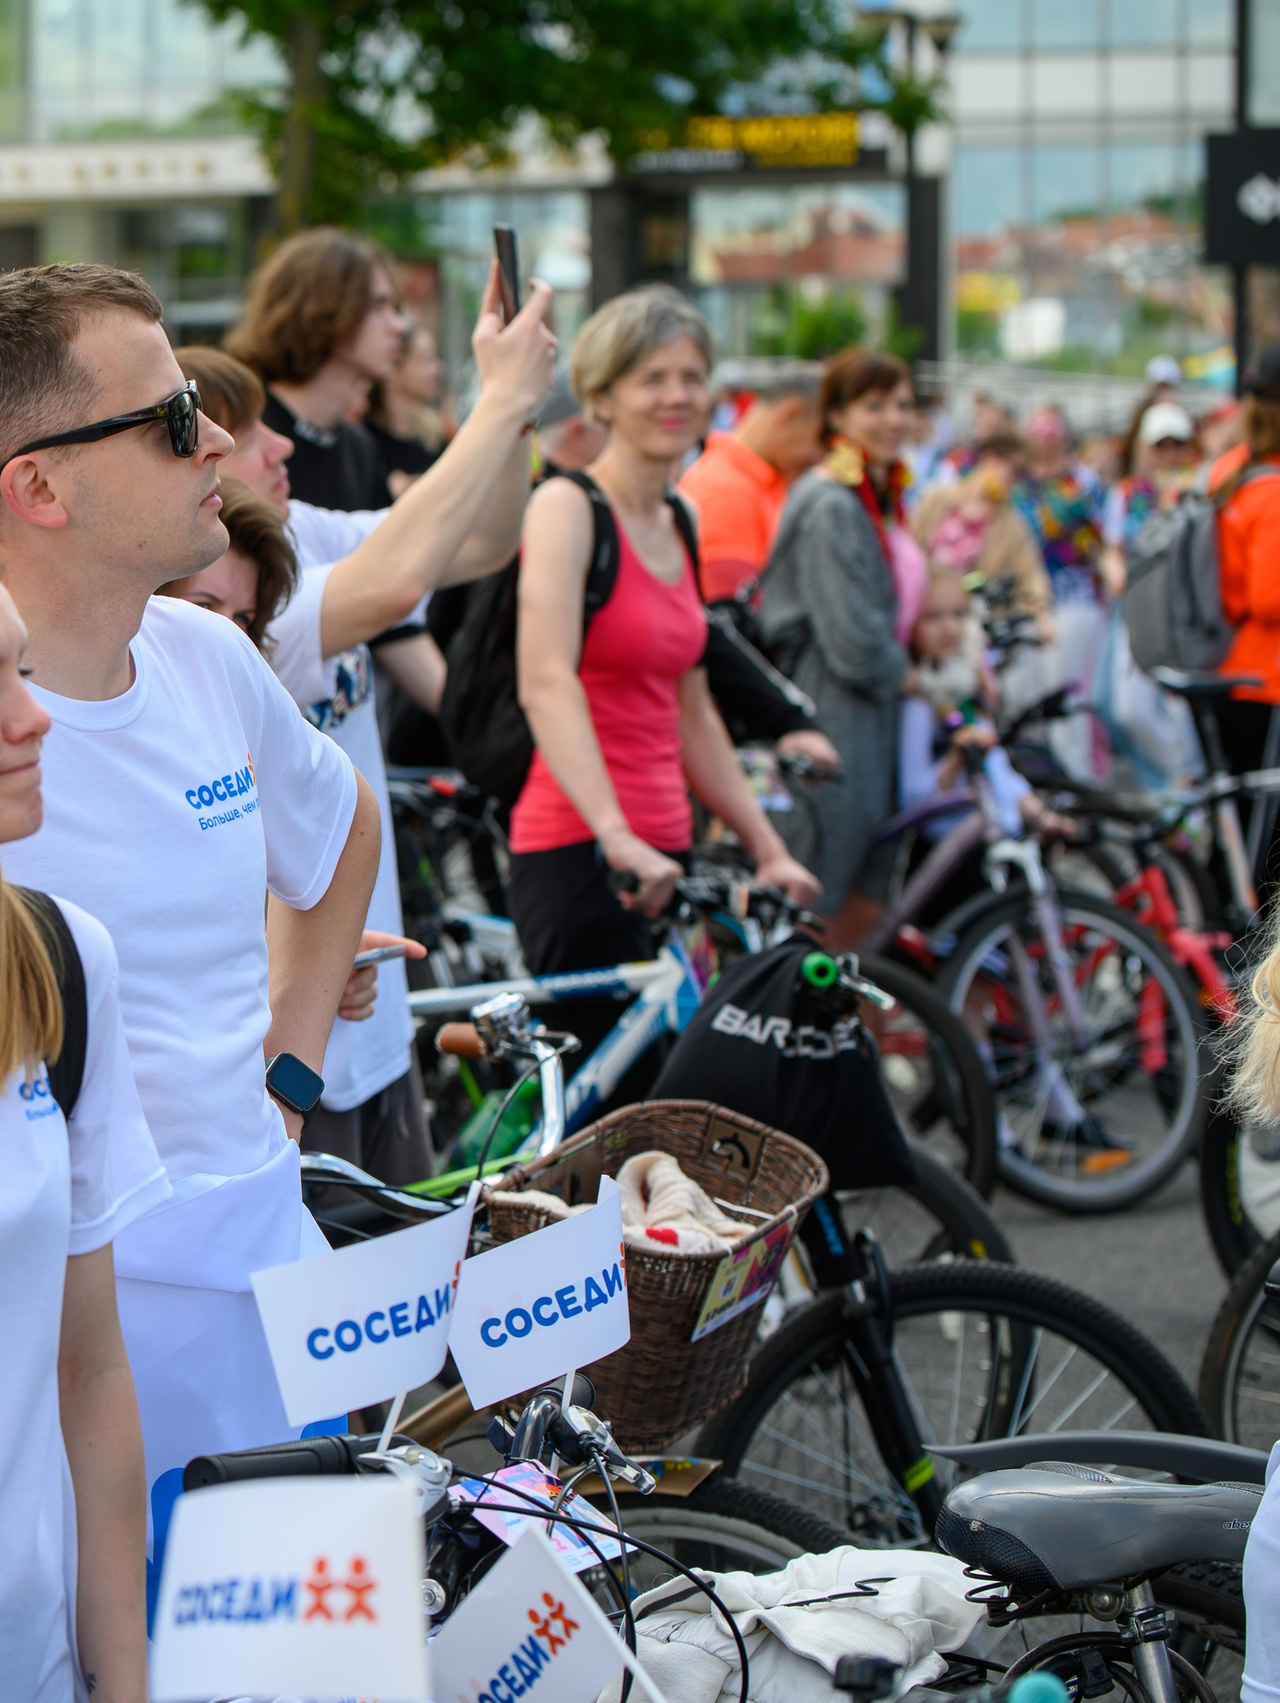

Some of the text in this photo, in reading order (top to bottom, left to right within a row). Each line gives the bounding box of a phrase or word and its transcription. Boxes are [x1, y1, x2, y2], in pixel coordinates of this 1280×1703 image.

[185, 766, 254, 810] СОСЕДИ
[198, 808, 244, 831] Больше,
[306, 1282, 450, 1361] СОСЕДИ
[480, 1262, 623, 1348] СОСЕДИ
[174, 1577, 298, 1626] СОСЕДИ
